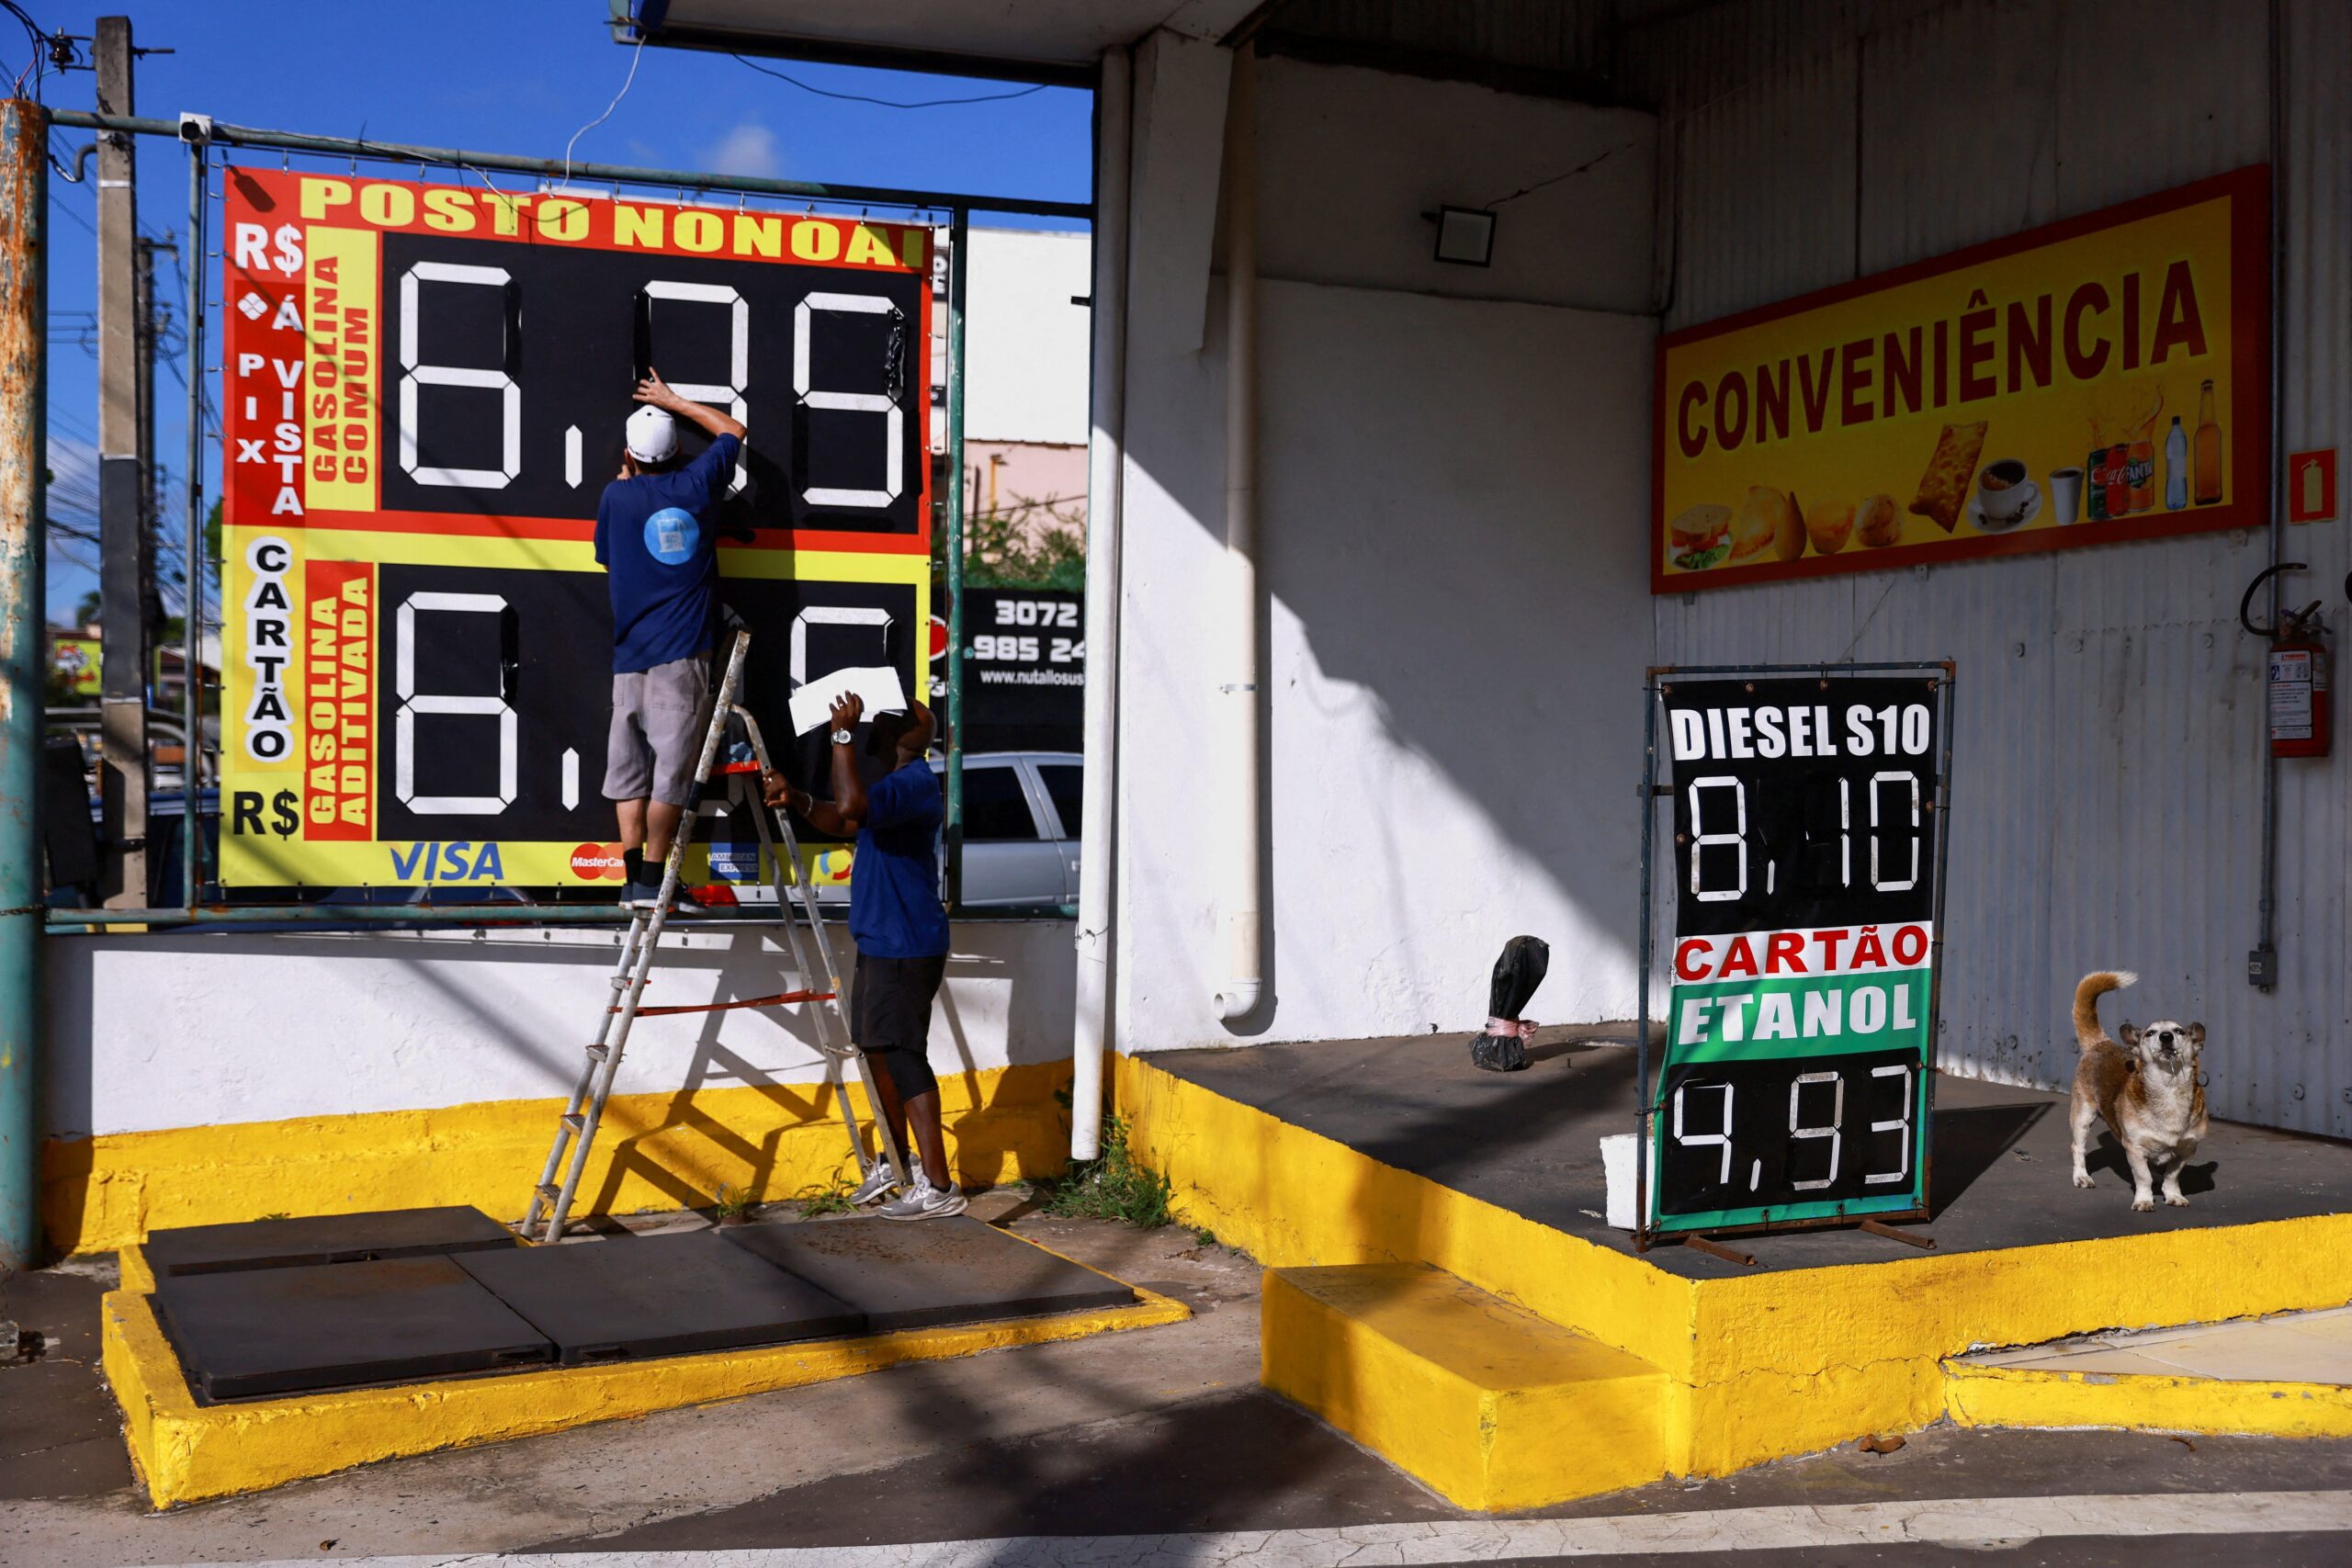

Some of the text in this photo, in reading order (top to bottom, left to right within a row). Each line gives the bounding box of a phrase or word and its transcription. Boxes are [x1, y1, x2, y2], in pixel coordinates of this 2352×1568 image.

[235, 222, 304, 277] R$
[300, 177, 924, 268] POSTO NONOAI
[313, 256, 338, 482] GASOLINA
[1679, 259, 2209, 457] CONVENIÊNCIA
[236, 353, 266, 464] PIX
[271, 295, 305, 515] Á VISTA
[344, 307, 368, 484] COMUM
[995, 600, 1078, 627] 3072
[252, 545, 288, 758] CARTÃO
[974, 635, 1039, 661] 985
[310, 596, 337, 824] GASOLINA
[341, 577, 368, 827] ADITIVADA
[1670, 704, 1930, 761] DIESEL S10
[233, 788, 300, 840] R$
[390, 842, 504, 881] VISA
[571, 857, 626, 867] MasterCar
[710, 852, 756, 862] AMERICAN
[718, 863, 758, 873] EXPRESS
[1675, 925, 1928, 981] CARTÃO
[1678, 984, 1917, 1045] ETANOL
